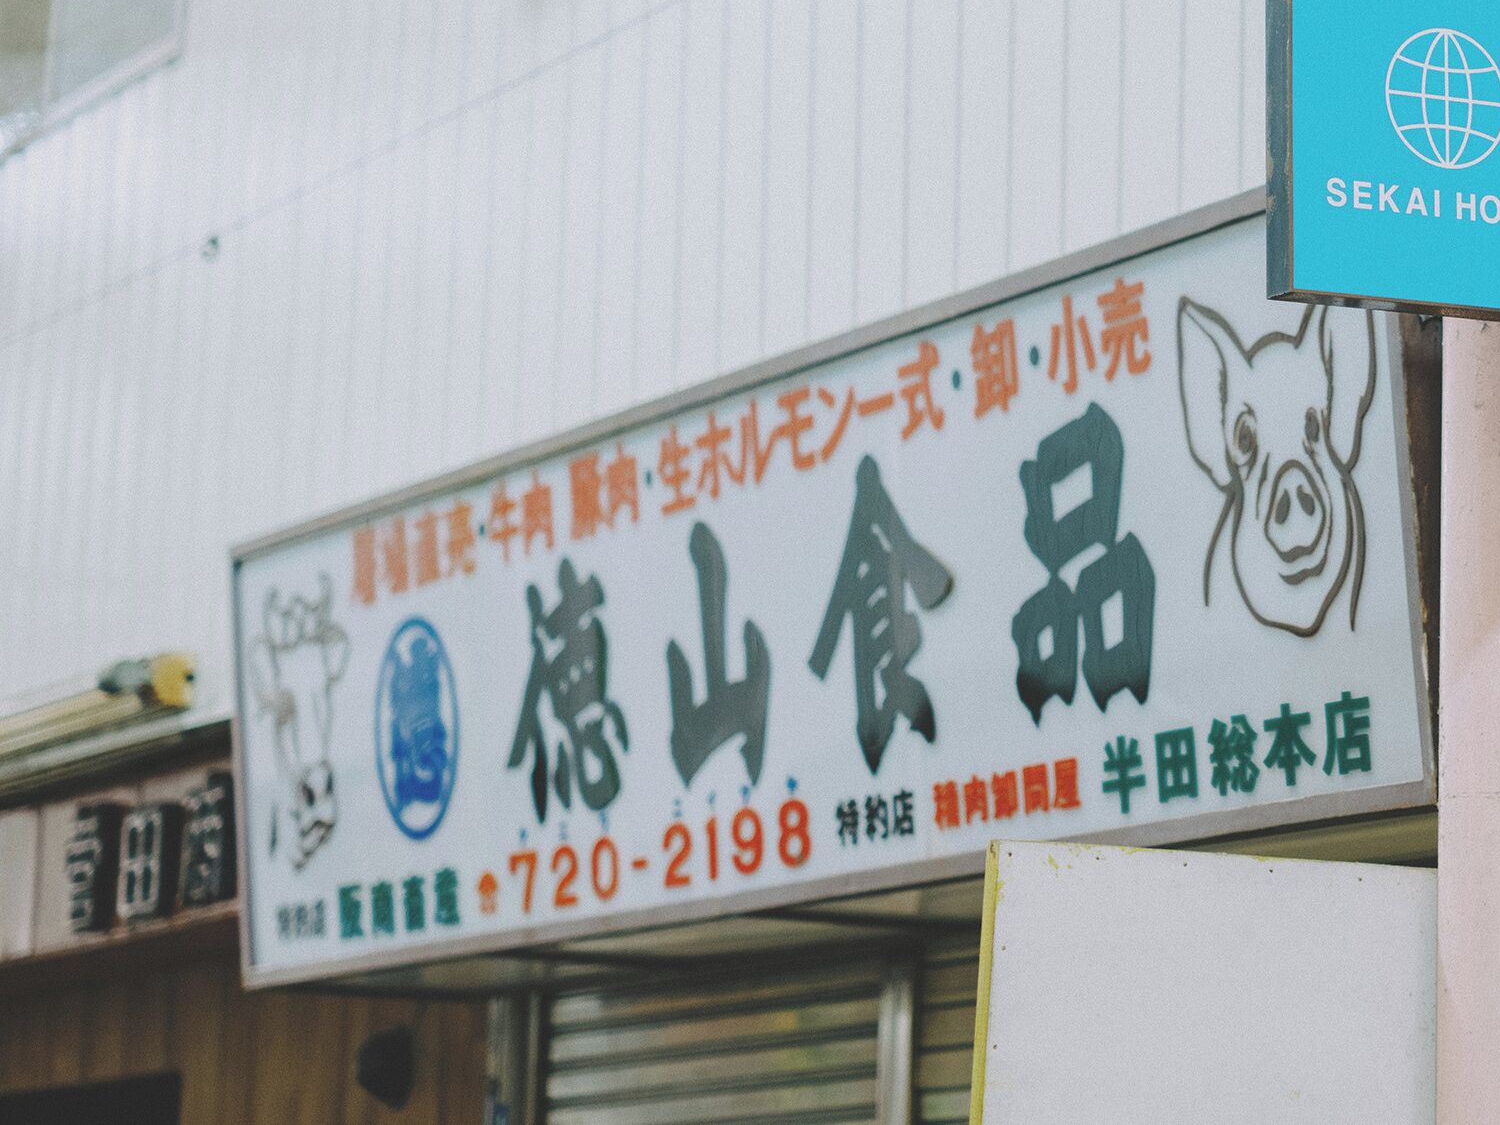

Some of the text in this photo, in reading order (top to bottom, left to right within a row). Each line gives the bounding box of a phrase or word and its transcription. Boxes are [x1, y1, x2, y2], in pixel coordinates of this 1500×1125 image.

[1326, 177, 1441, 217] SEKAI
[507, 402, 1156, 825] 徳山食品
[509, 800, 811, 914] 720-2198
[1101, 691, 1373, 814] 半田総本店
